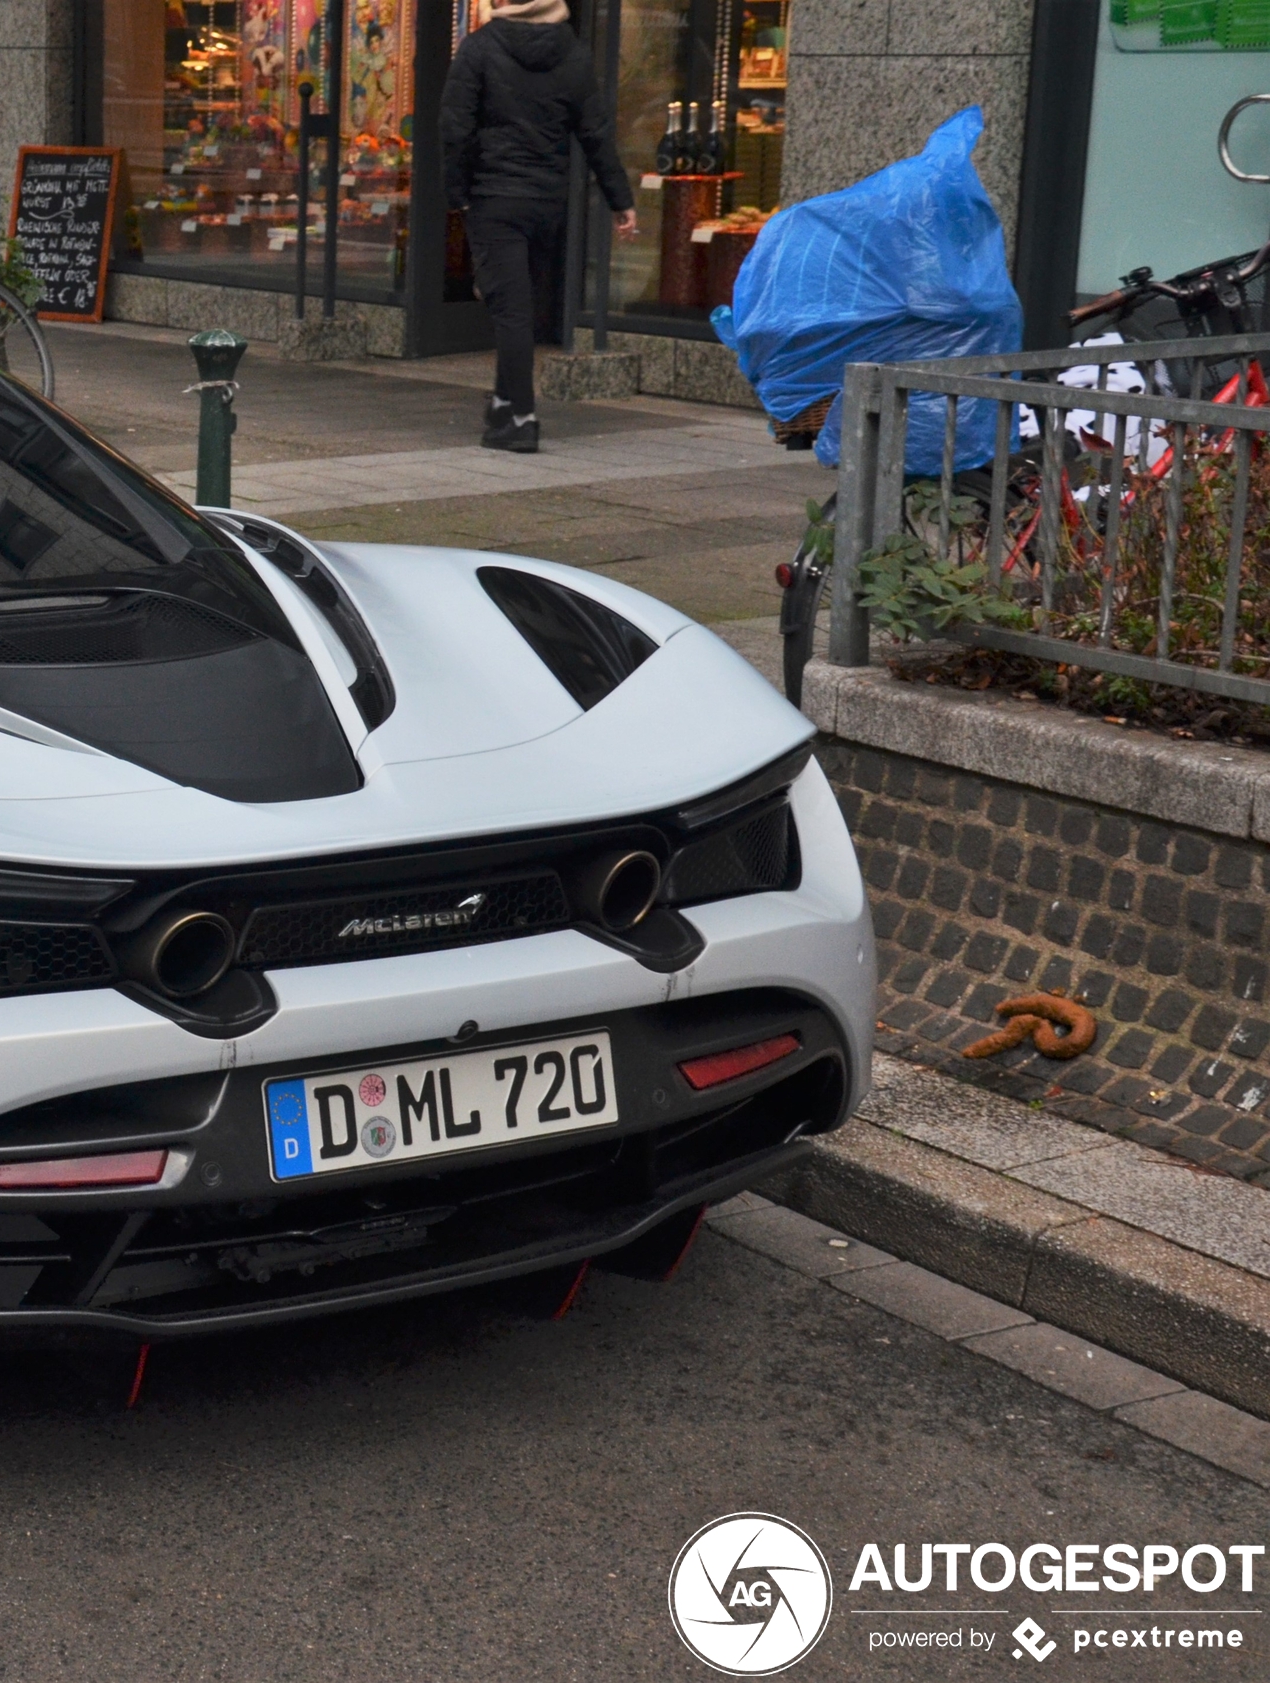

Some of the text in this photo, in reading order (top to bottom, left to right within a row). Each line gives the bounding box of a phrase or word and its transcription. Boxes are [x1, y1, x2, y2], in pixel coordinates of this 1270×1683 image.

[22, 196, 52, 209] WURST
[338, 910, 473, 938] McLaren
[314, 1084, 359, 1160] D
[396, 1068, 482, 1146] ML
[493, 1044, 607, 1129] 720
[284, 1137, 299, 1159] D
